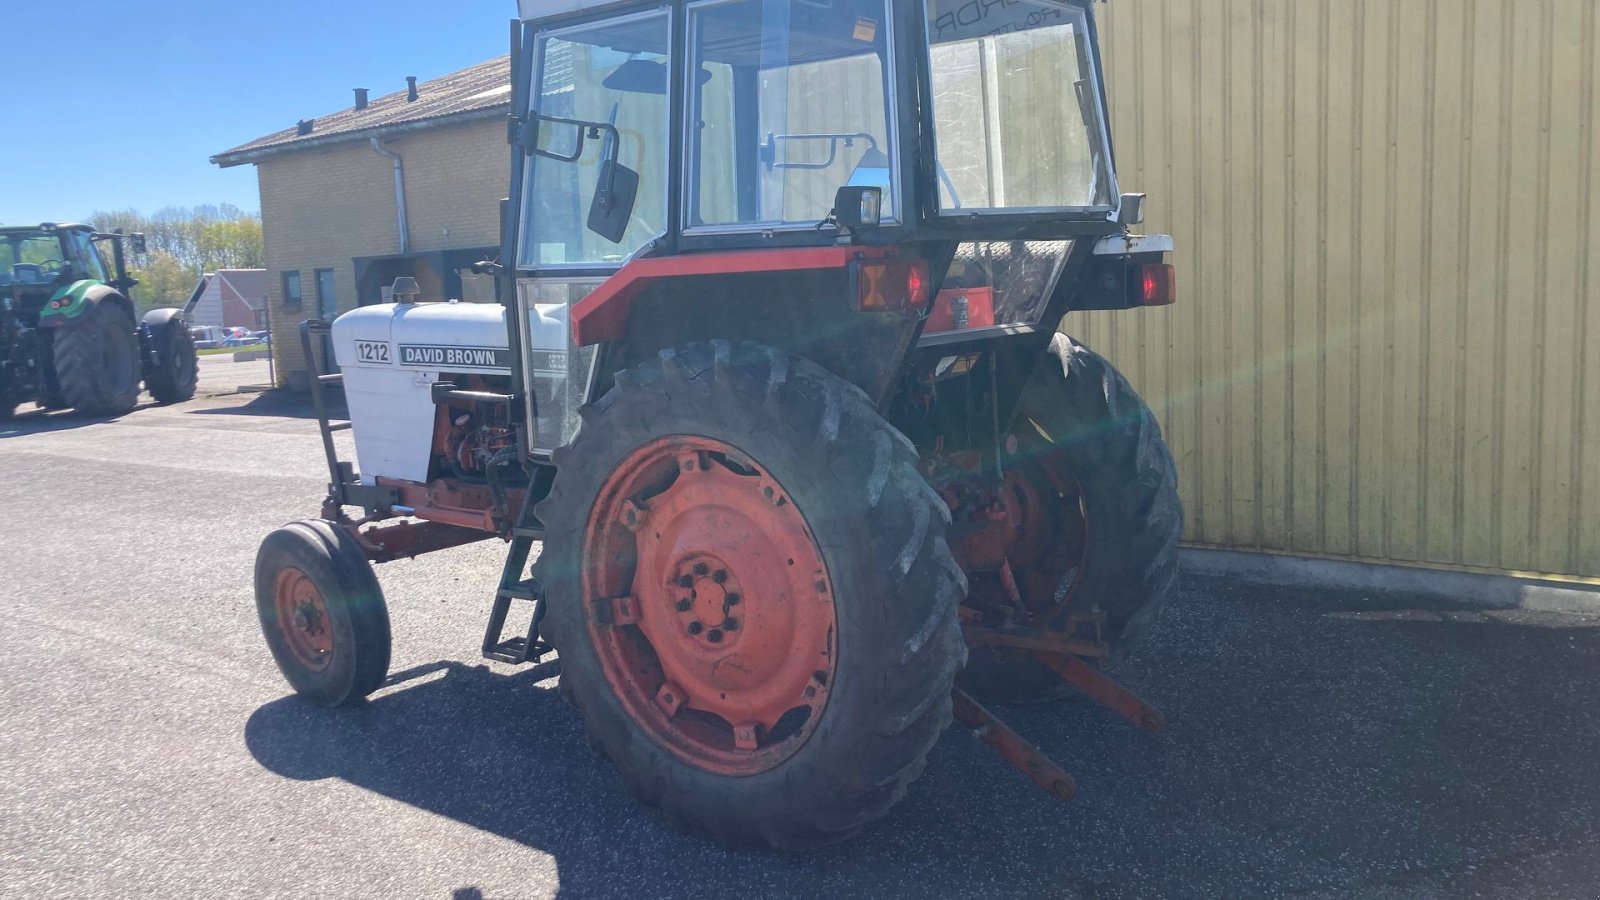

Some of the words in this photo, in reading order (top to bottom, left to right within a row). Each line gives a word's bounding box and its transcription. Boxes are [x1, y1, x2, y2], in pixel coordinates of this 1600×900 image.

[358, 343, 389, 361] 1212
[406, 347, 443, 364] DAVID
[446, 348, 496, 366] BROWN
